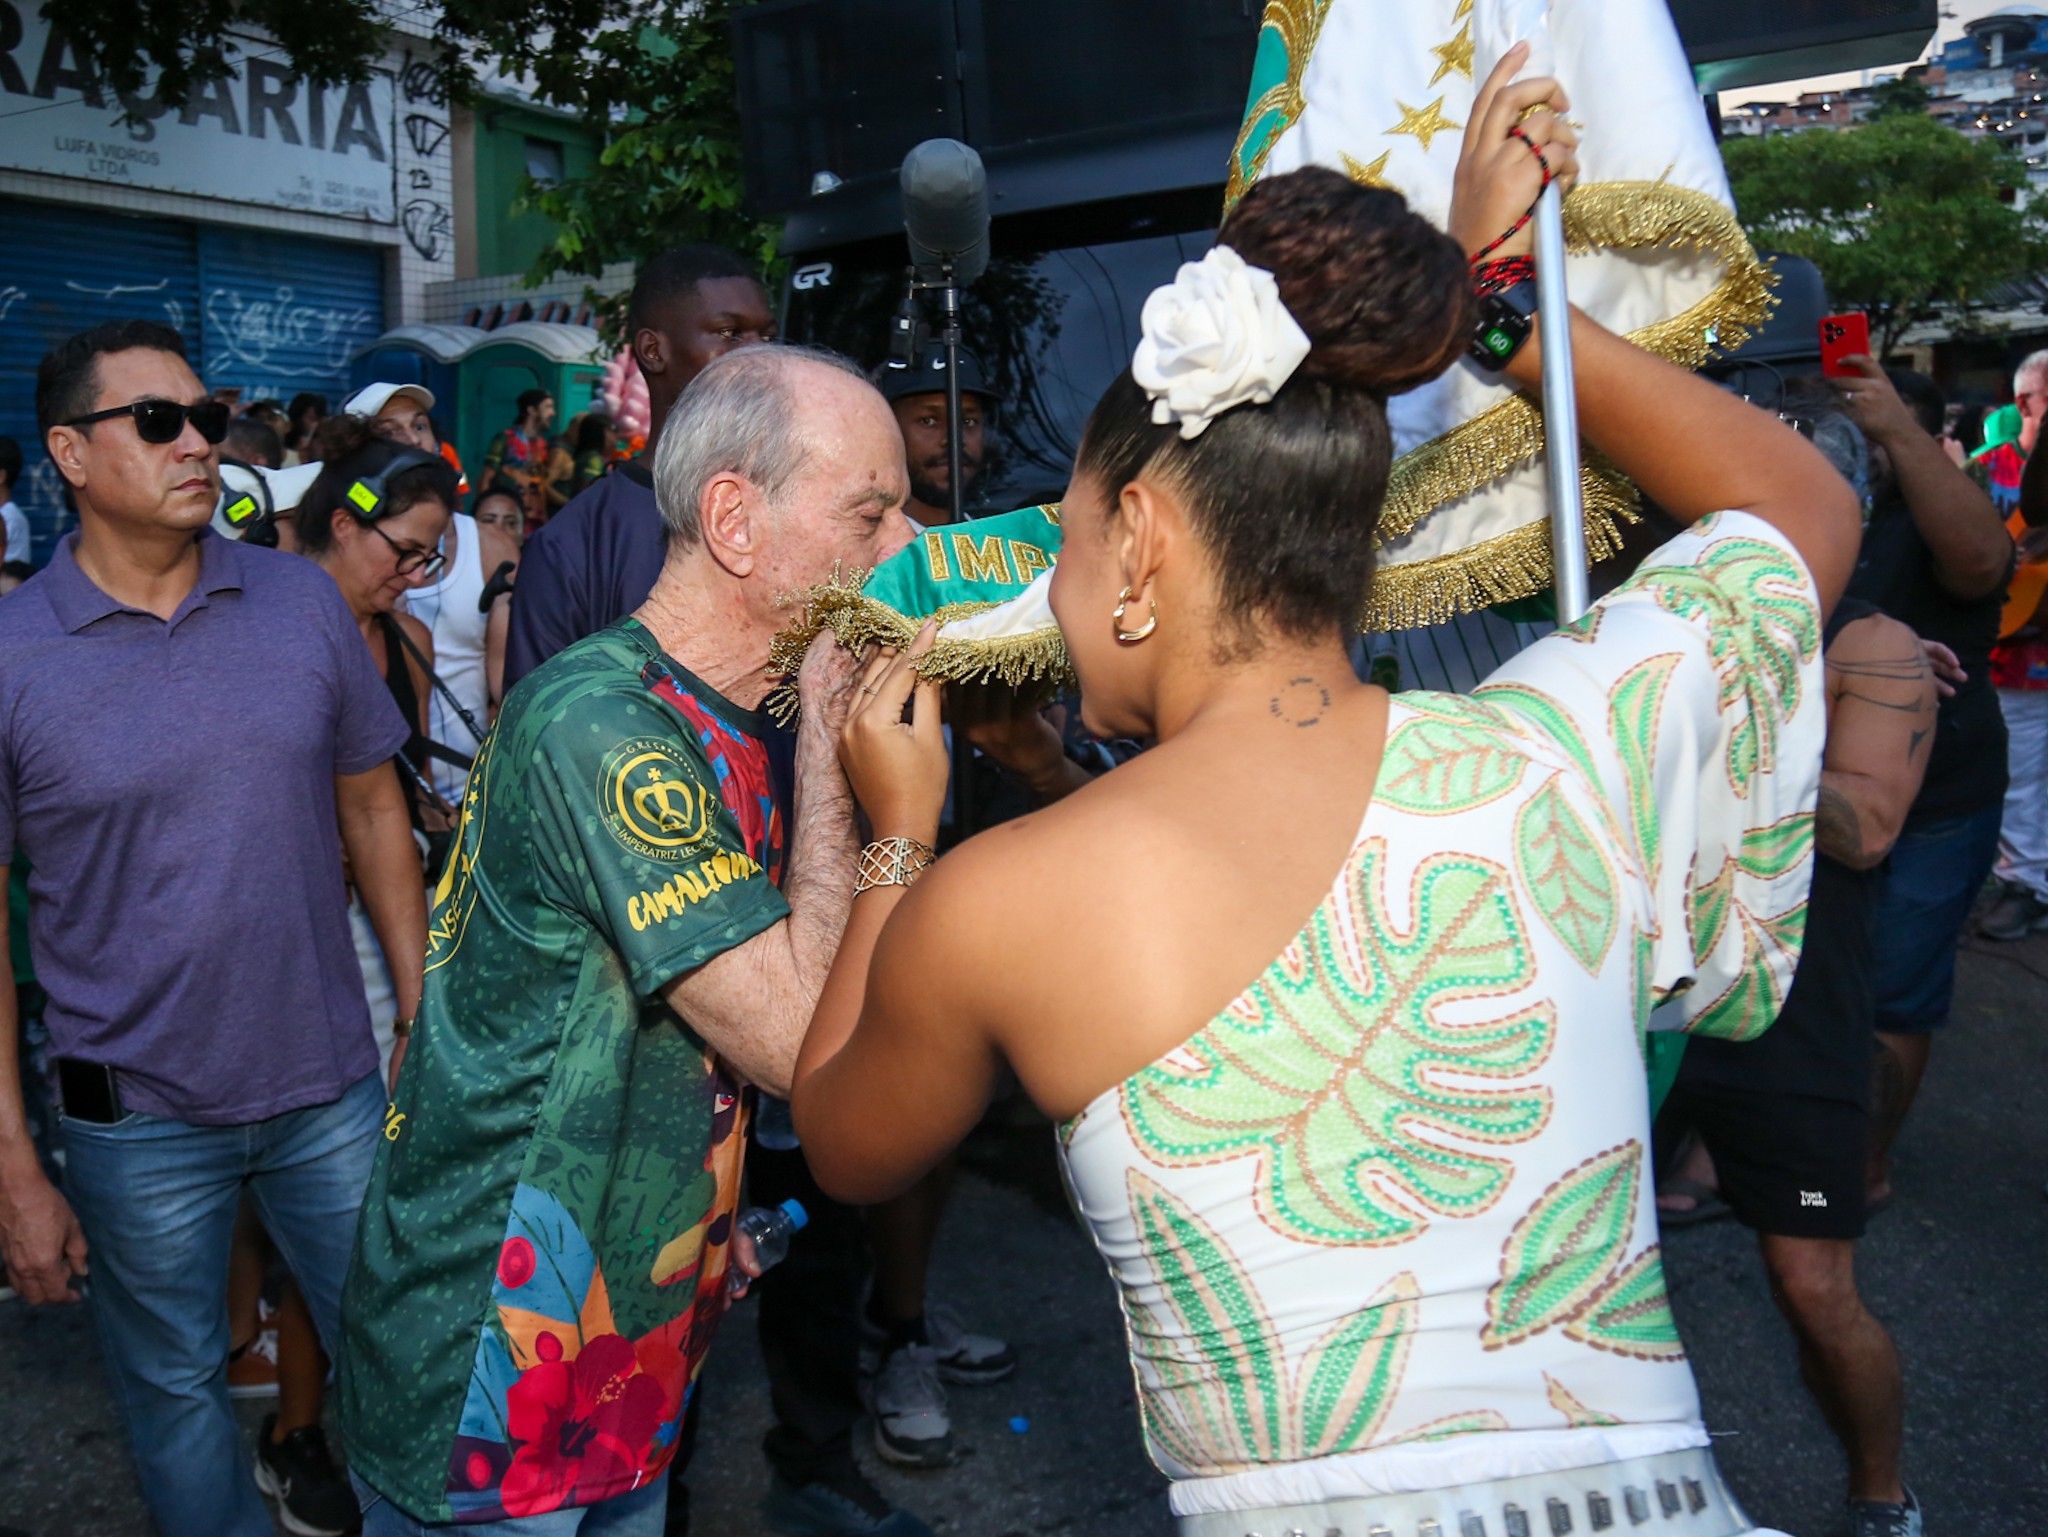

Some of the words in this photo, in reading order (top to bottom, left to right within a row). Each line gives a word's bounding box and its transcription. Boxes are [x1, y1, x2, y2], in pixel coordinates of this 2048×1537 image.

[54, 135, 98, 157] LUFA
[99, 141, 161, 167] VIDROS
[88, 157, 130, 177] LTDA
[924, 532, 1058, 585] IMP
[617, 828, 679, 861] IMPERATRIZ
